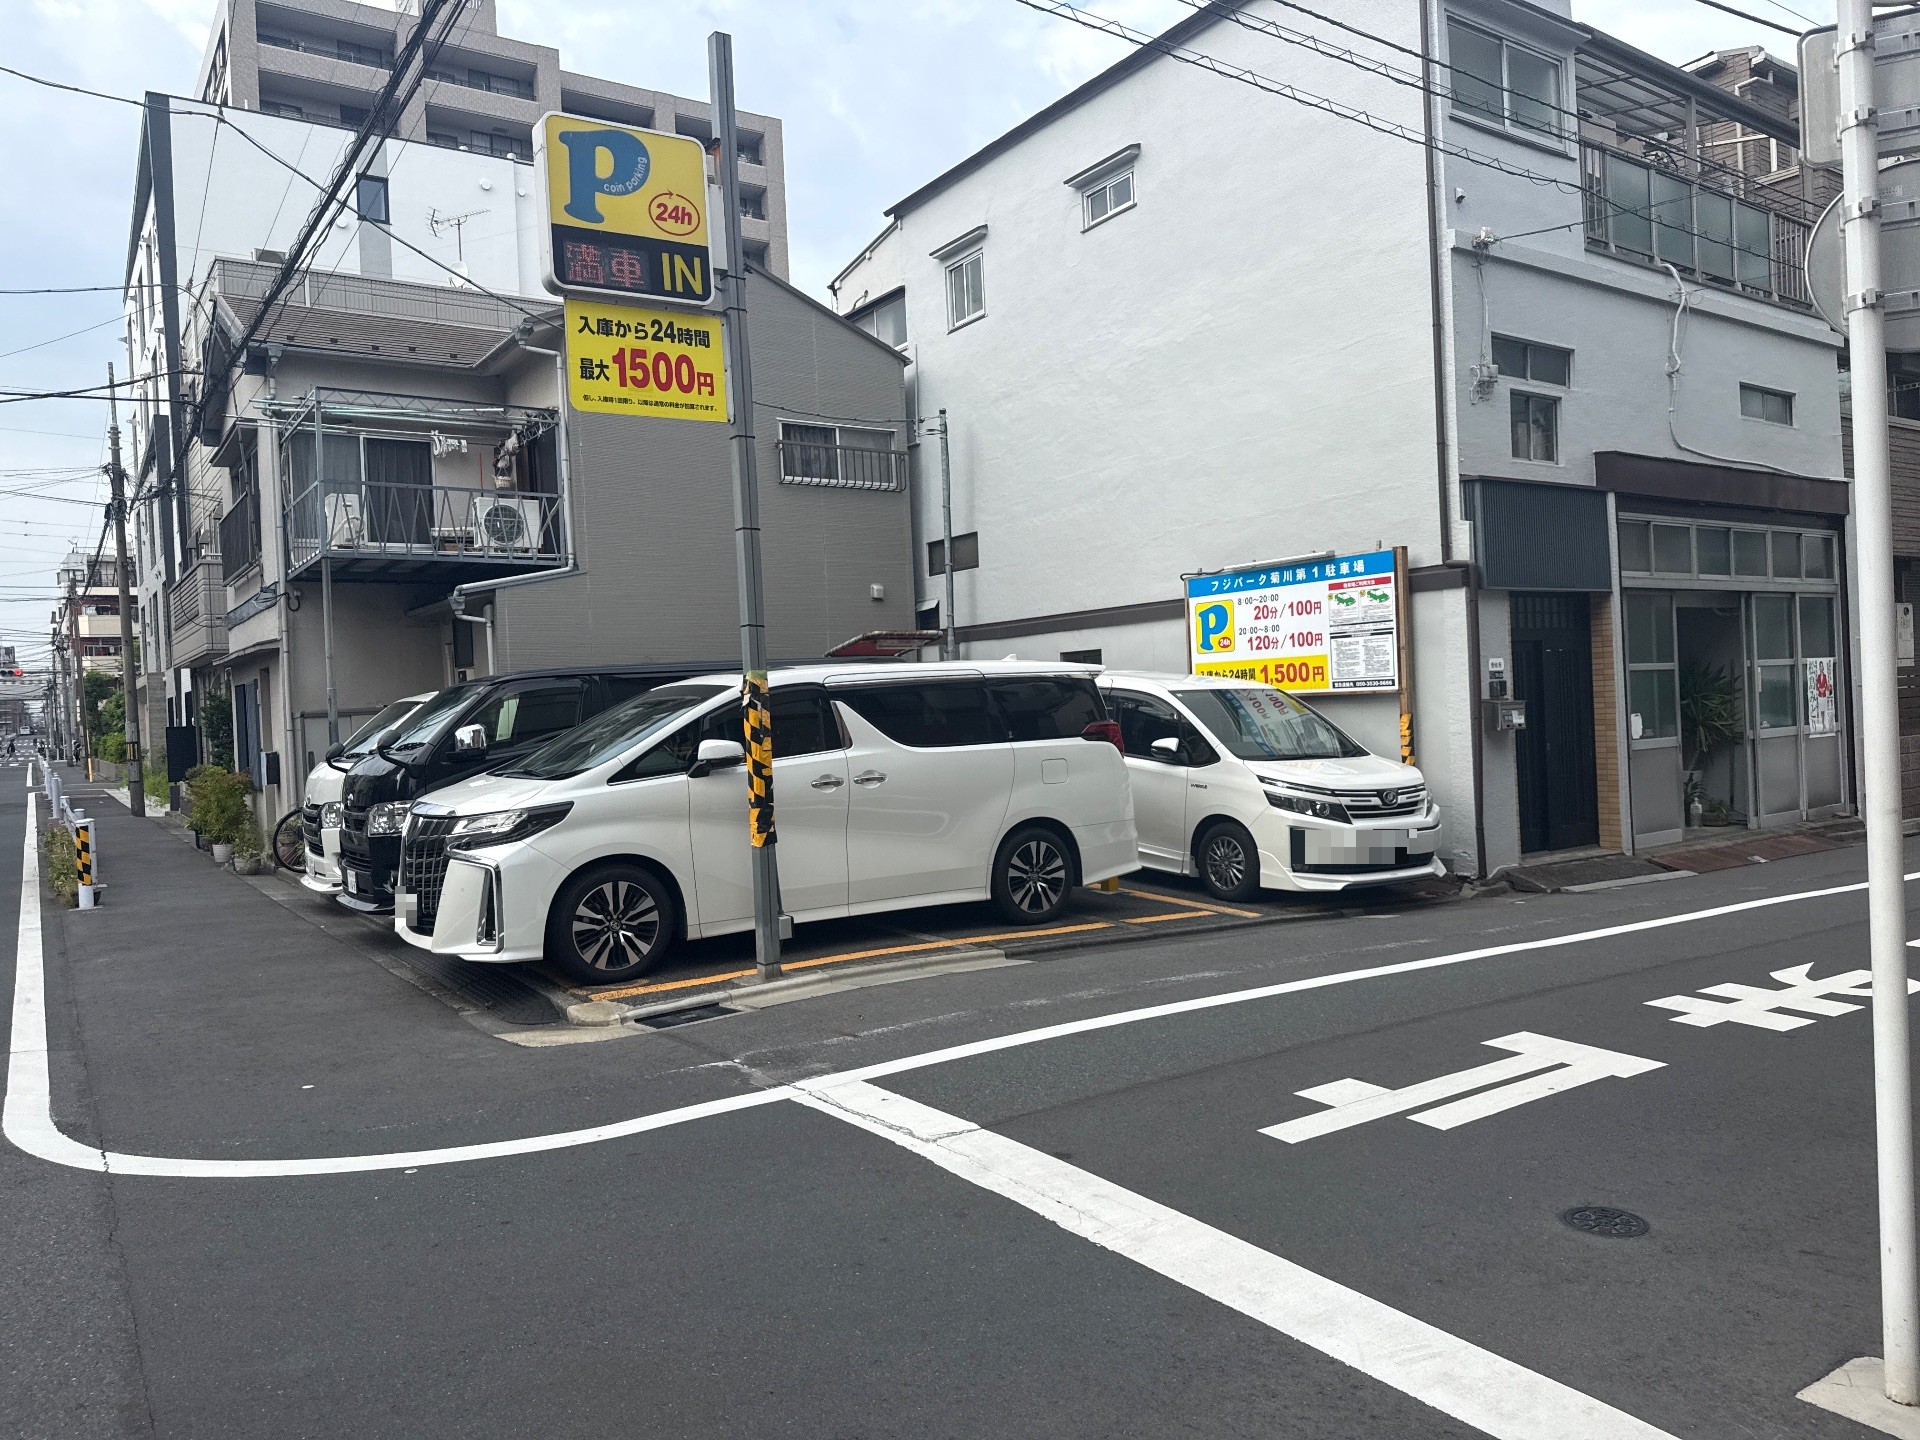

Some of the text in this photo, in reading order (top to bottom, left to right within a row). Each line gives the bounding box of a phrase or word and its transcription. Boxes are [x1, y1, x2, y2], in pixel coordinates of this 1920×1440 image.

[558, 129, 650, 223] P
[603, 157, 648, 192] coin parking
[655, 203, 693, 225] 24h
[567, 244, 645, 287] 満車
[661, 252, 703, 294] IN
[578, 316, 710, 348] 入庫から24時間
[579, 347, 715, 396] 最大1500円
[1199, 605, 1228, 650] P
[1260, 662, 1324, 685] 1,500円
